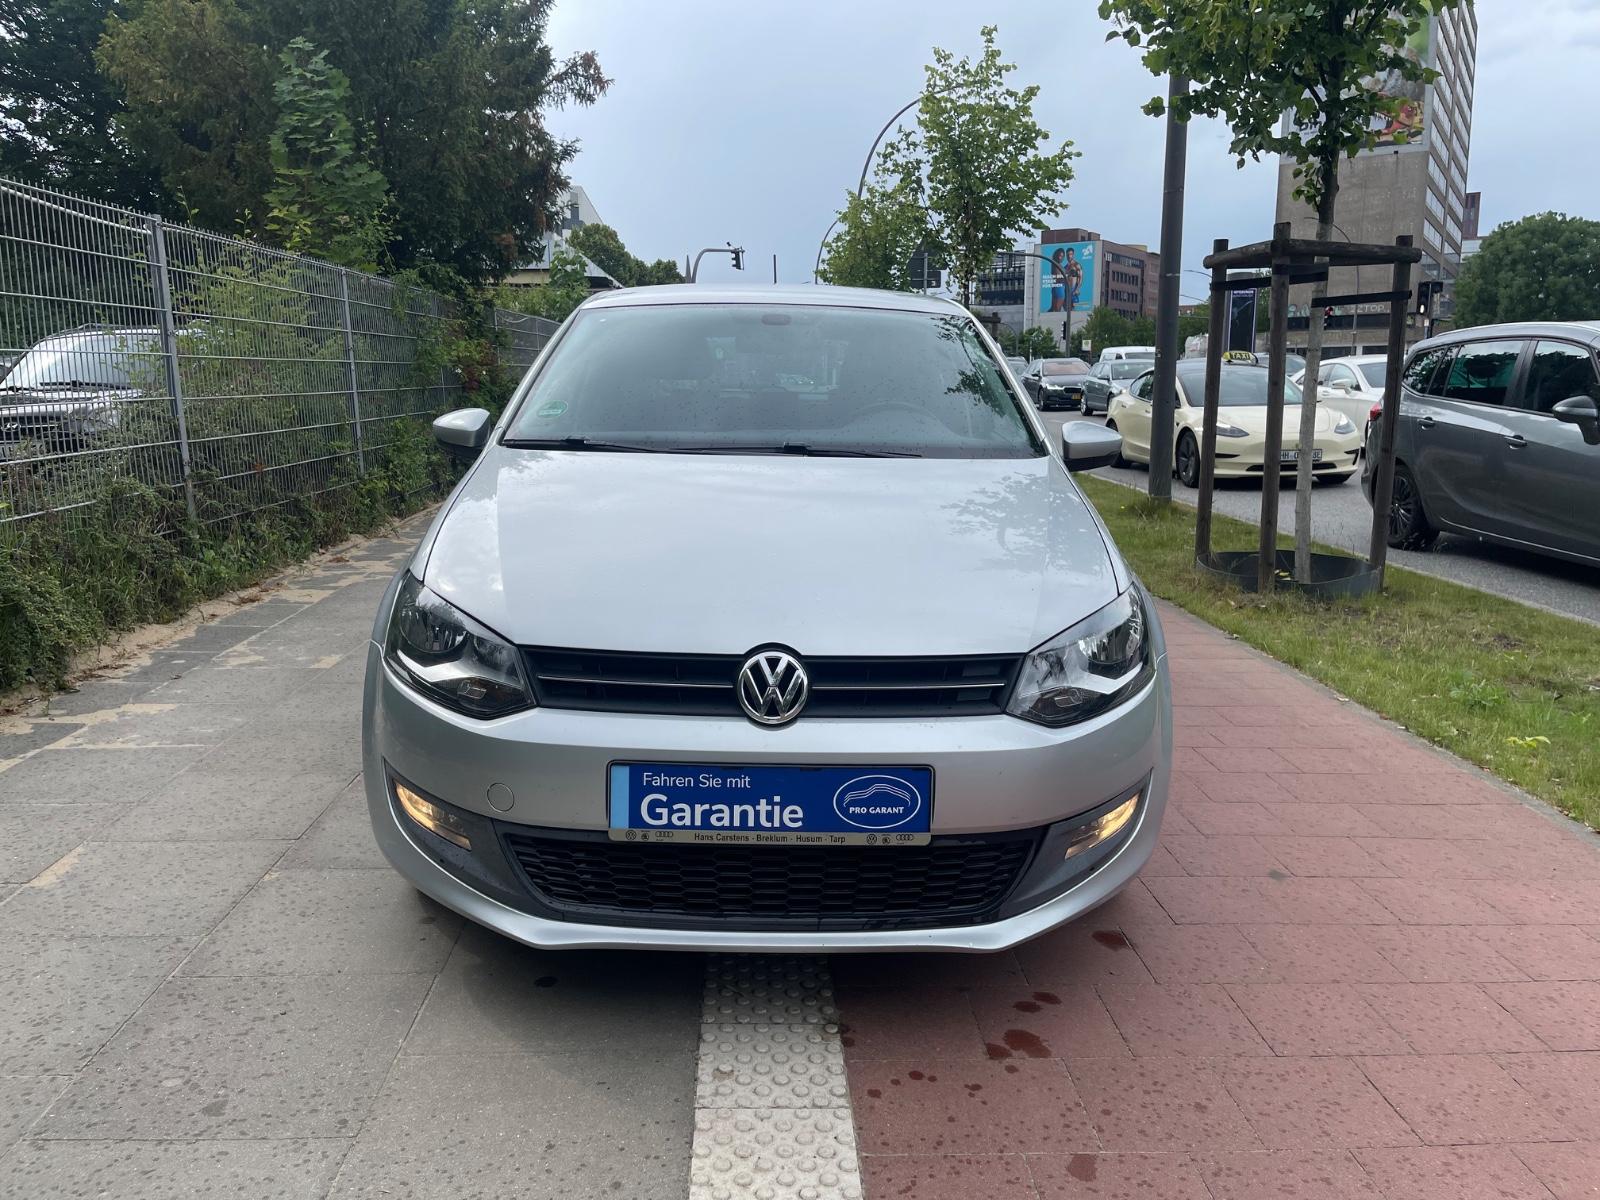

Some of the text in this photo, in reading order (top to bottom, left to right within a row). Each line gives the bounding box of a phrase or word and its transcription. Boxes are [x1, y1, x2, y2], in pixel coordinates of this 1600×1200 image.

[1232, 352, 1251, 360] TAXI
[643, 772, 751, 788] Fahren Sie mit
[640, 793, 804, 828] Garantie
[849, 806, 904, 814] PRO GARANT
[694, 833, 846, 844] Hans Carstens Breklum Husum Tarp
